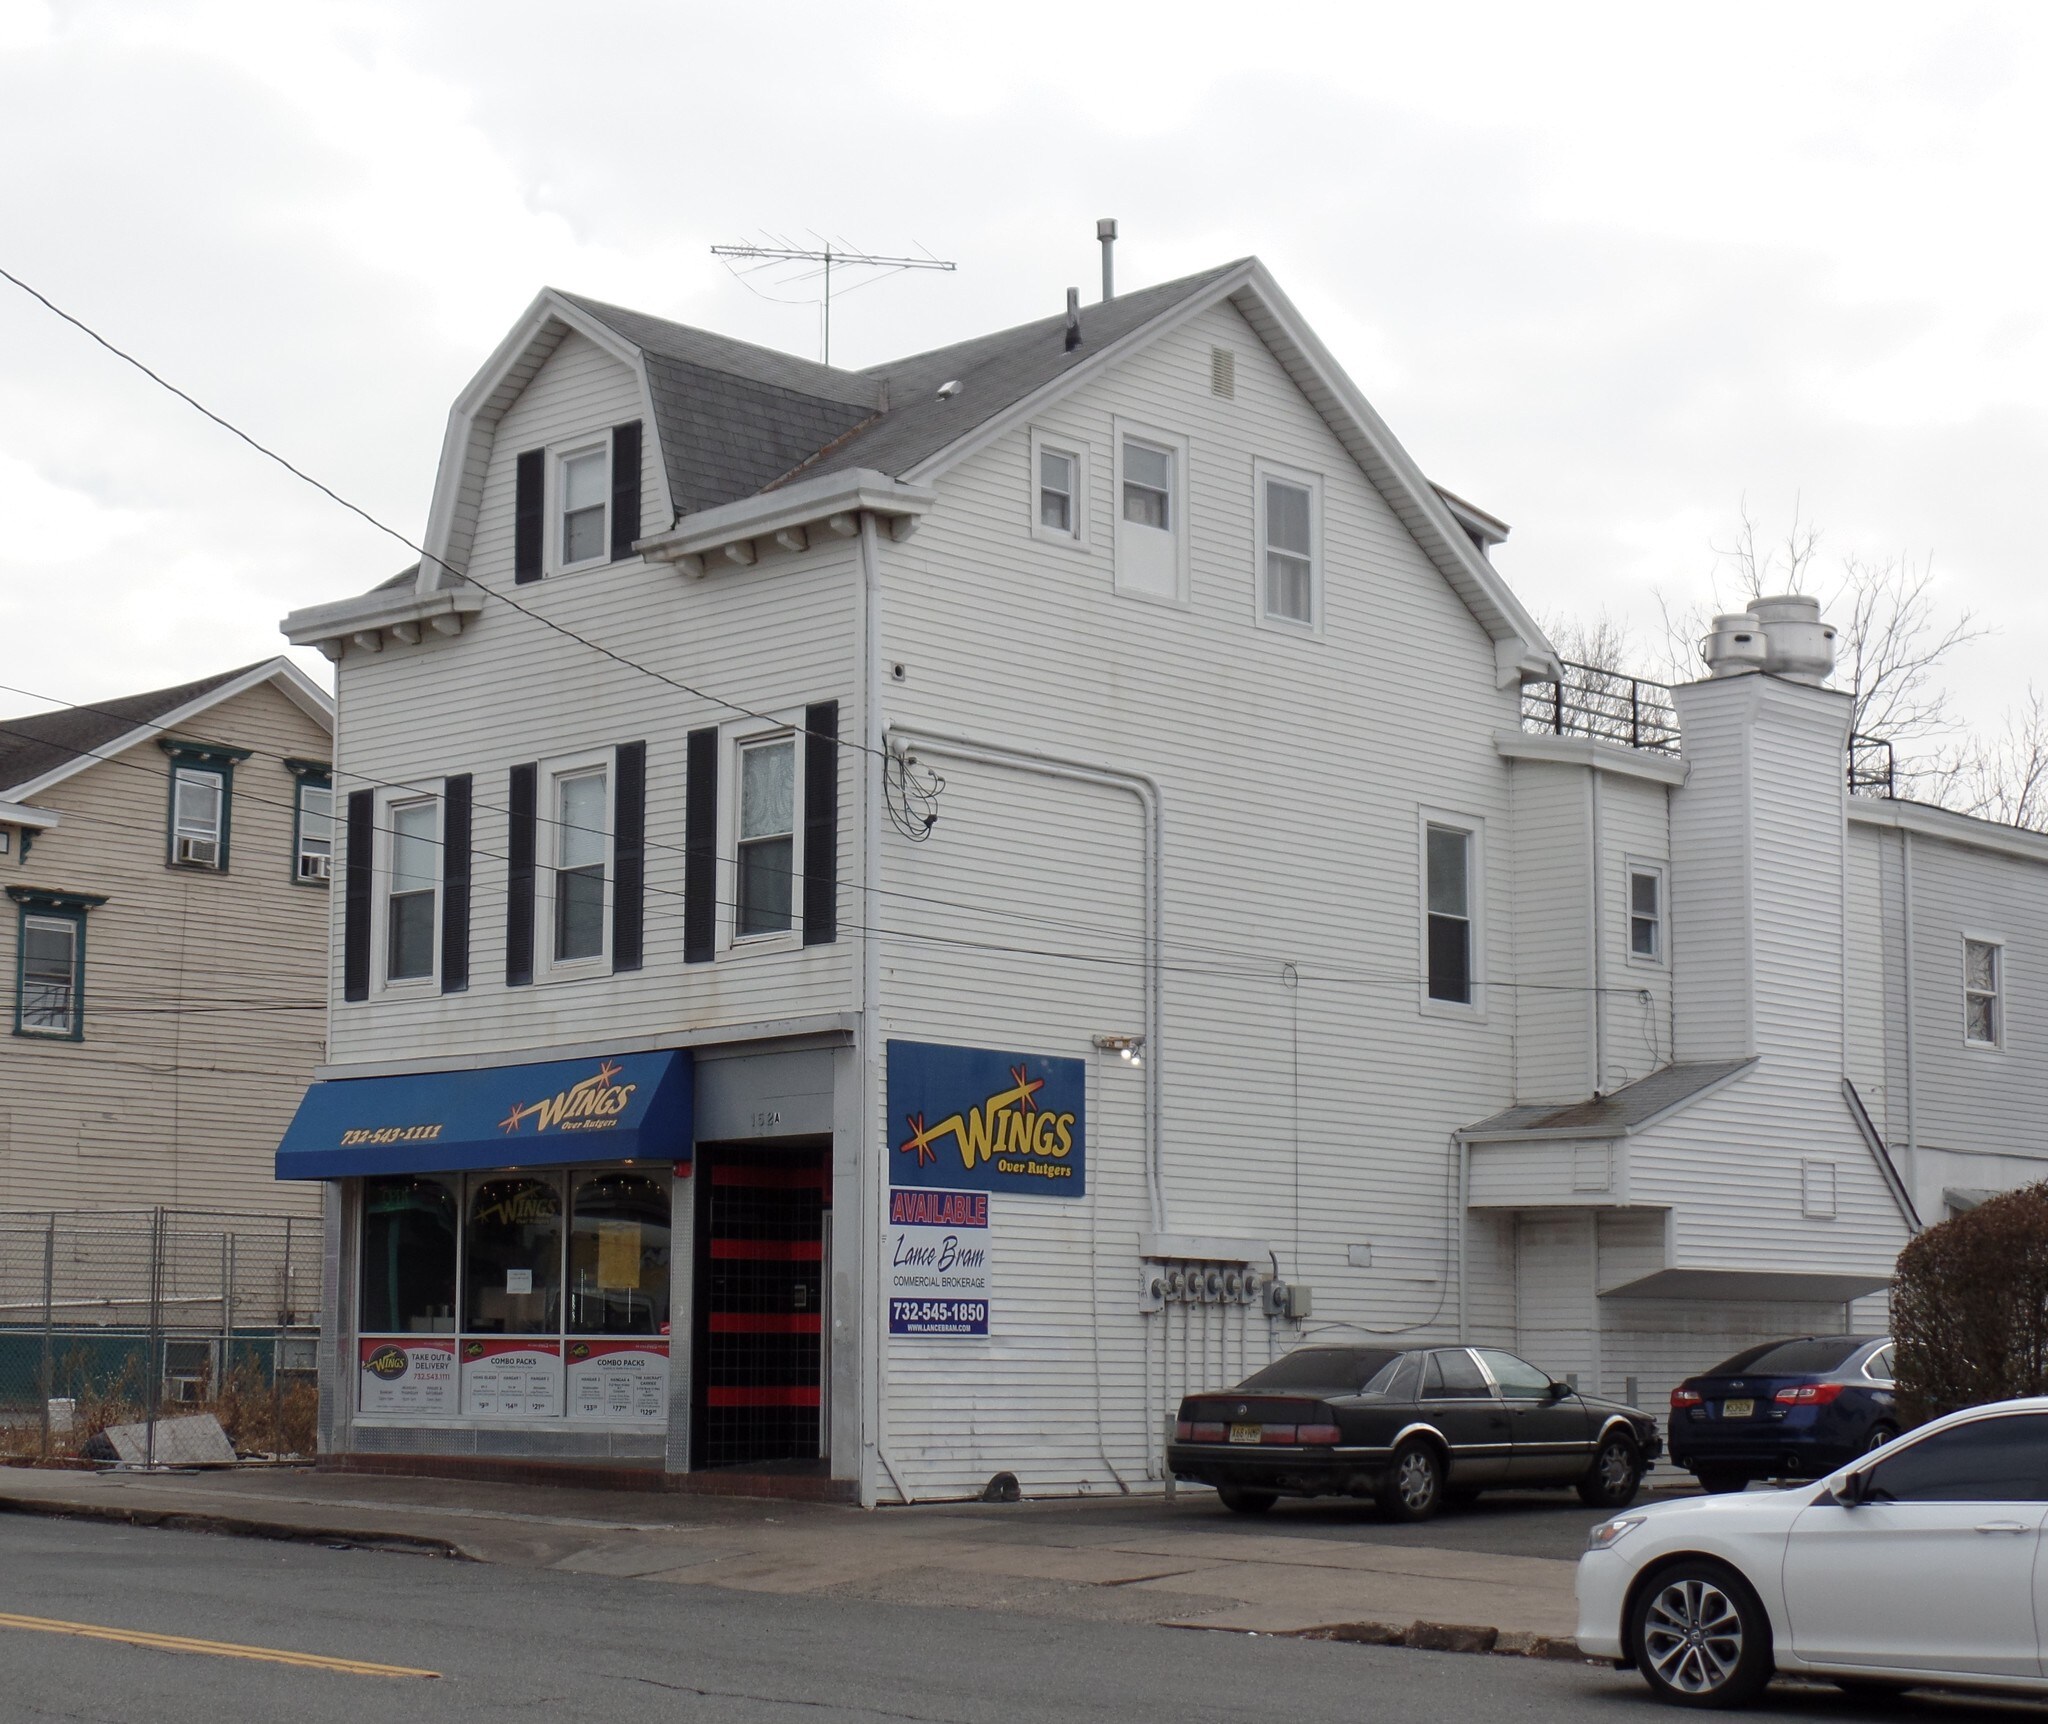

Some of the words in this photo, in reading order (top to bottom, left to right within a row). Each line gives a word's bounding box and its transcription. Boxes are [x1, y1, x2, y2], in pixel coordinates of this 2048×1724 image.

[508, 1066, 637, 1131] WINGS
[340, 1124, 443, 1145] 732-543-1111
[561, 1121, 583, 1130] Over
[583, 1119, 618, 1129] Rutgers
[913, 1081, 1076, 1169] WINGS
[998, 1159, 1026, 1173] Over
[1027, 1161, 1073, 1179] Rutgers
[486, 1188, 557, 1225] WINGS
[892, 1192, 988, 1226] AVAILABLE
[893, 1233, 938, 1268] Lance
[938, 1234, 986, 1273] Bram
[893, 1275, 940, 1288] COMMERCIAL
[941, 1276, 986, 1289] BROKERAGE
[893, 1301, 986, 1322] 732-545-1850
[907, 1322, 972, 1333] WWW.LANCEBRAM.COM
[366, 1352, 405, 1372] WINGS
[415, 1362, 450, 1370] DELIVERY
[597, 1359, 623, 1367] COMBO
[623, 1359, 645, 1367] PACKS
